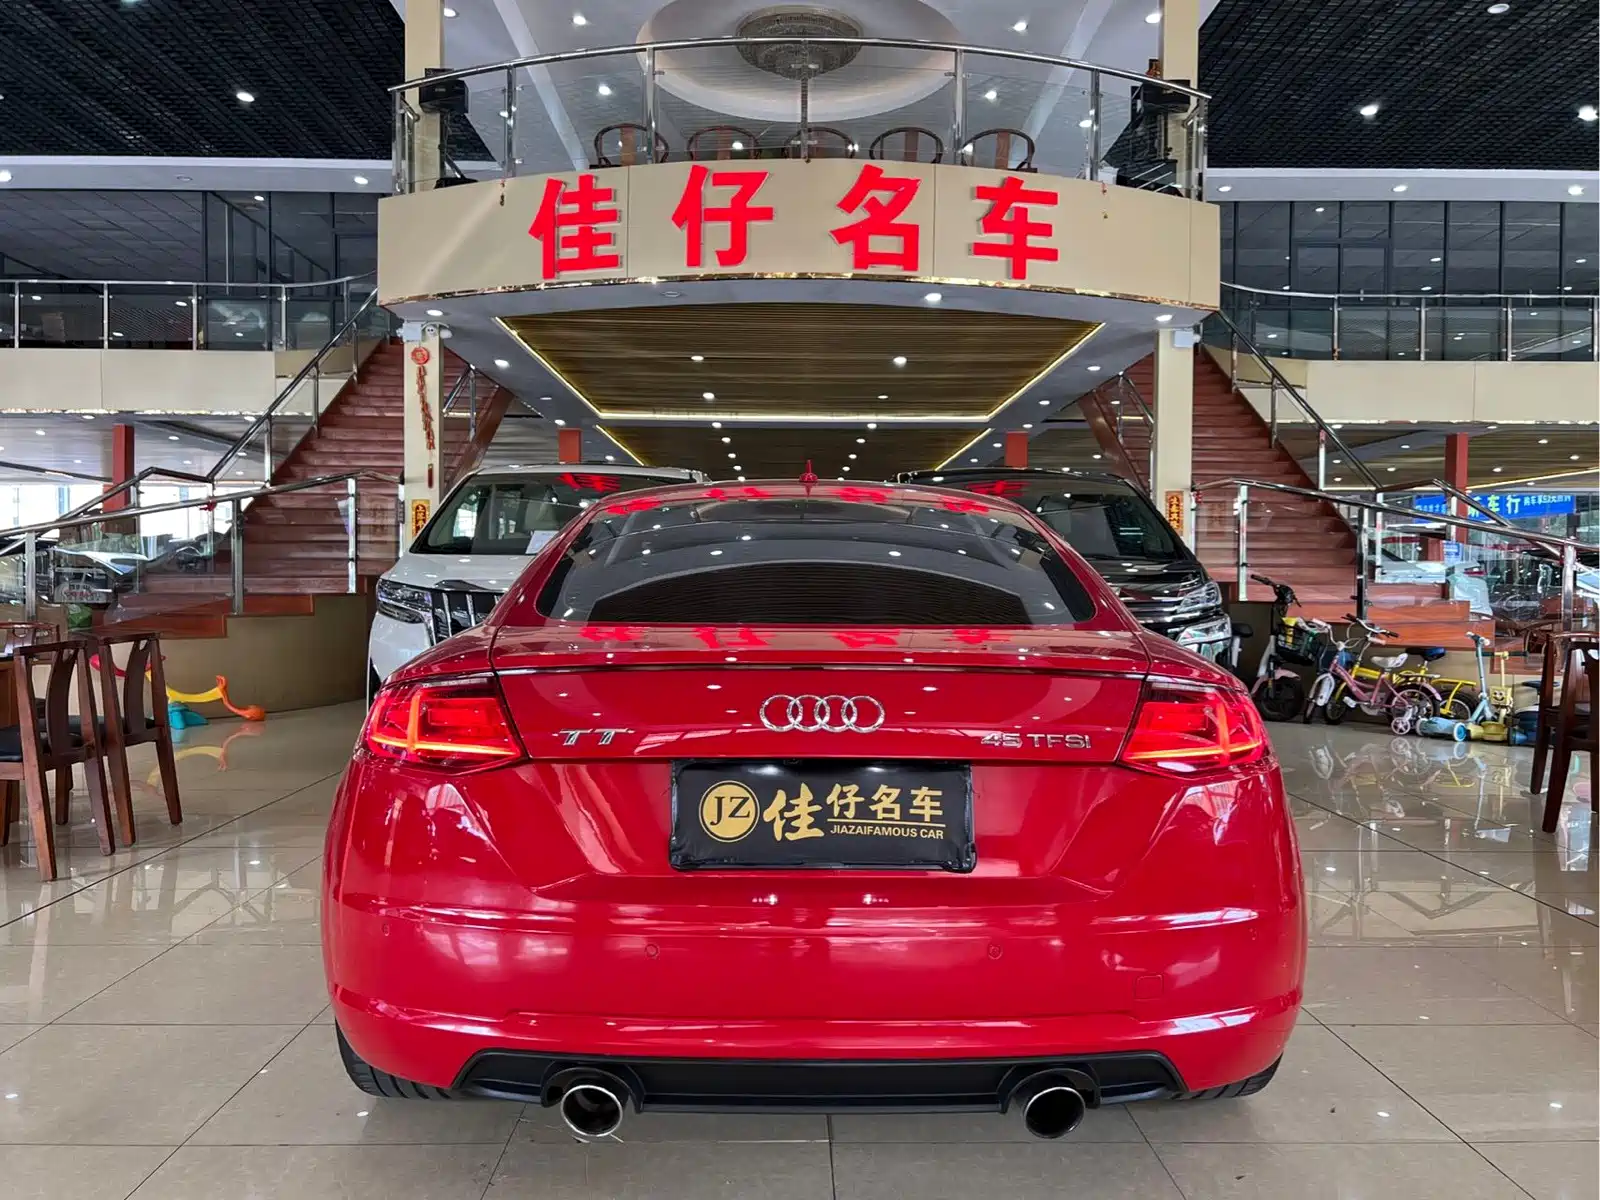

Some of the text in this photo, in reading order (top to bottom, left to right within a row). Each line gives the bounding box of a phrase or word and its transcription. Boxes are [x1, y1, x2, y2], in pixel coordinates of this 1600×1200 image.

[527, 164, 1059, 280] 佳仔名车
[559, 728, 628, 746] TT
[981, 732, 1092, 749] 45 TFSI
[709, 796, 751, 826] JZ
[762, 782, 944, 841] 佳仔名车
[830, 824, 944, 840] JIAZAIFAMOUS CAR
